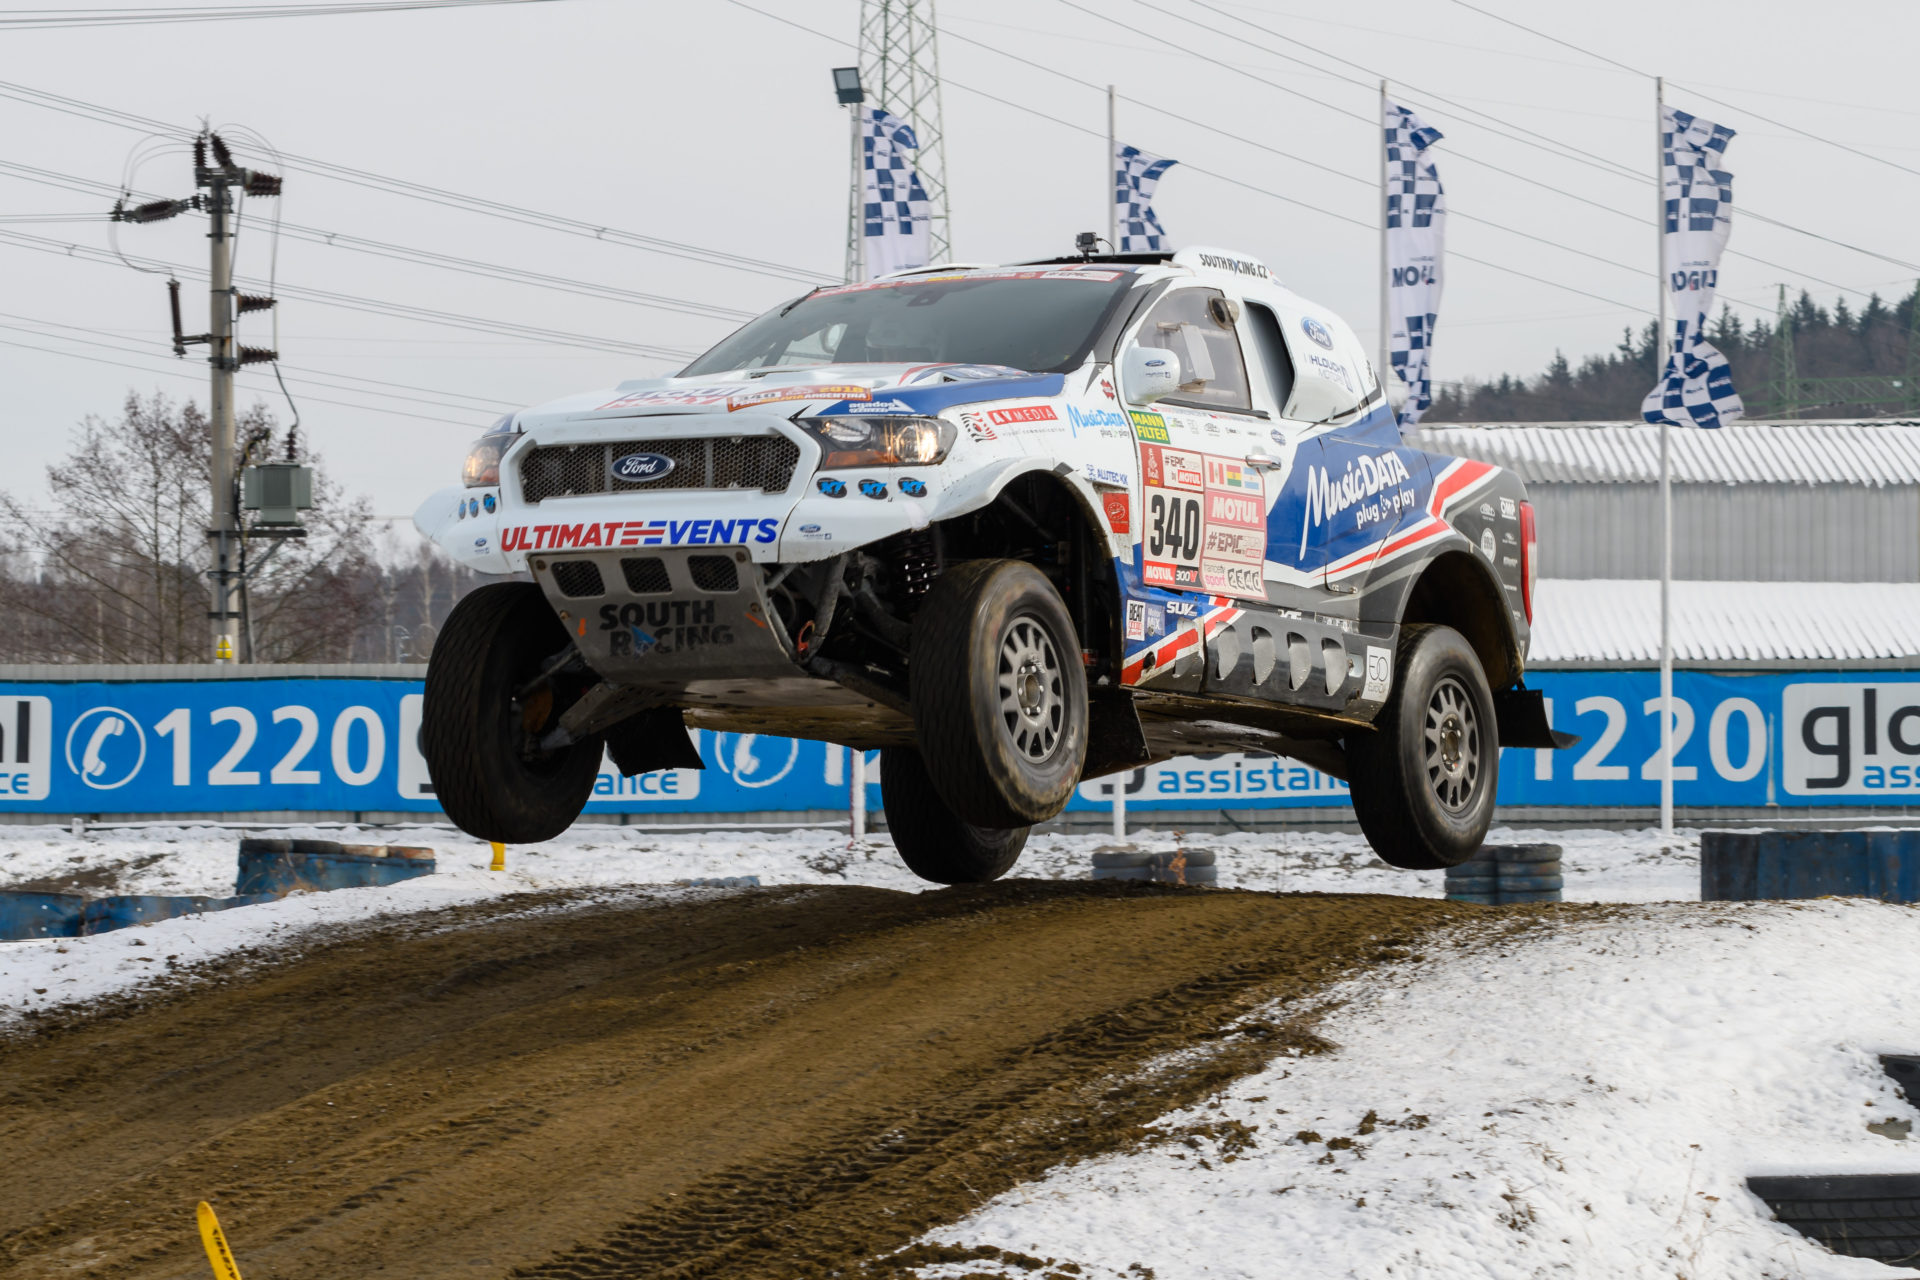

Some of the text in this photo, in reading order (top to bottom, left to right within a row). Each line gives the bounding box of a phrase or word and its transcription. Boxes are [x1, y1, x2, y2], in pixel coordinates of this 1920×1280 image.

[1131, 412, 1165, 427] MANN
[1136, 425, 1168, 441] FILTER
[1179, 471, 1200, 485] MOTUL
[1211, 496, 1259, 524] MOTUL
[1356, 488, 1415, 530] plug play
[1150, 494, 1200, 560] 340
[1145, 564, 1198, 583] MOTUL 300V
[1205, 575, 1227, 587] sport
[599, 600, 715, 631] SOUTH
[153, 705, 386, 787] 1220
[1801, 688, 1920, 789] glo
[1158, 761, 1350, 794] assistan
[1862, 765, 1920, 789] as
